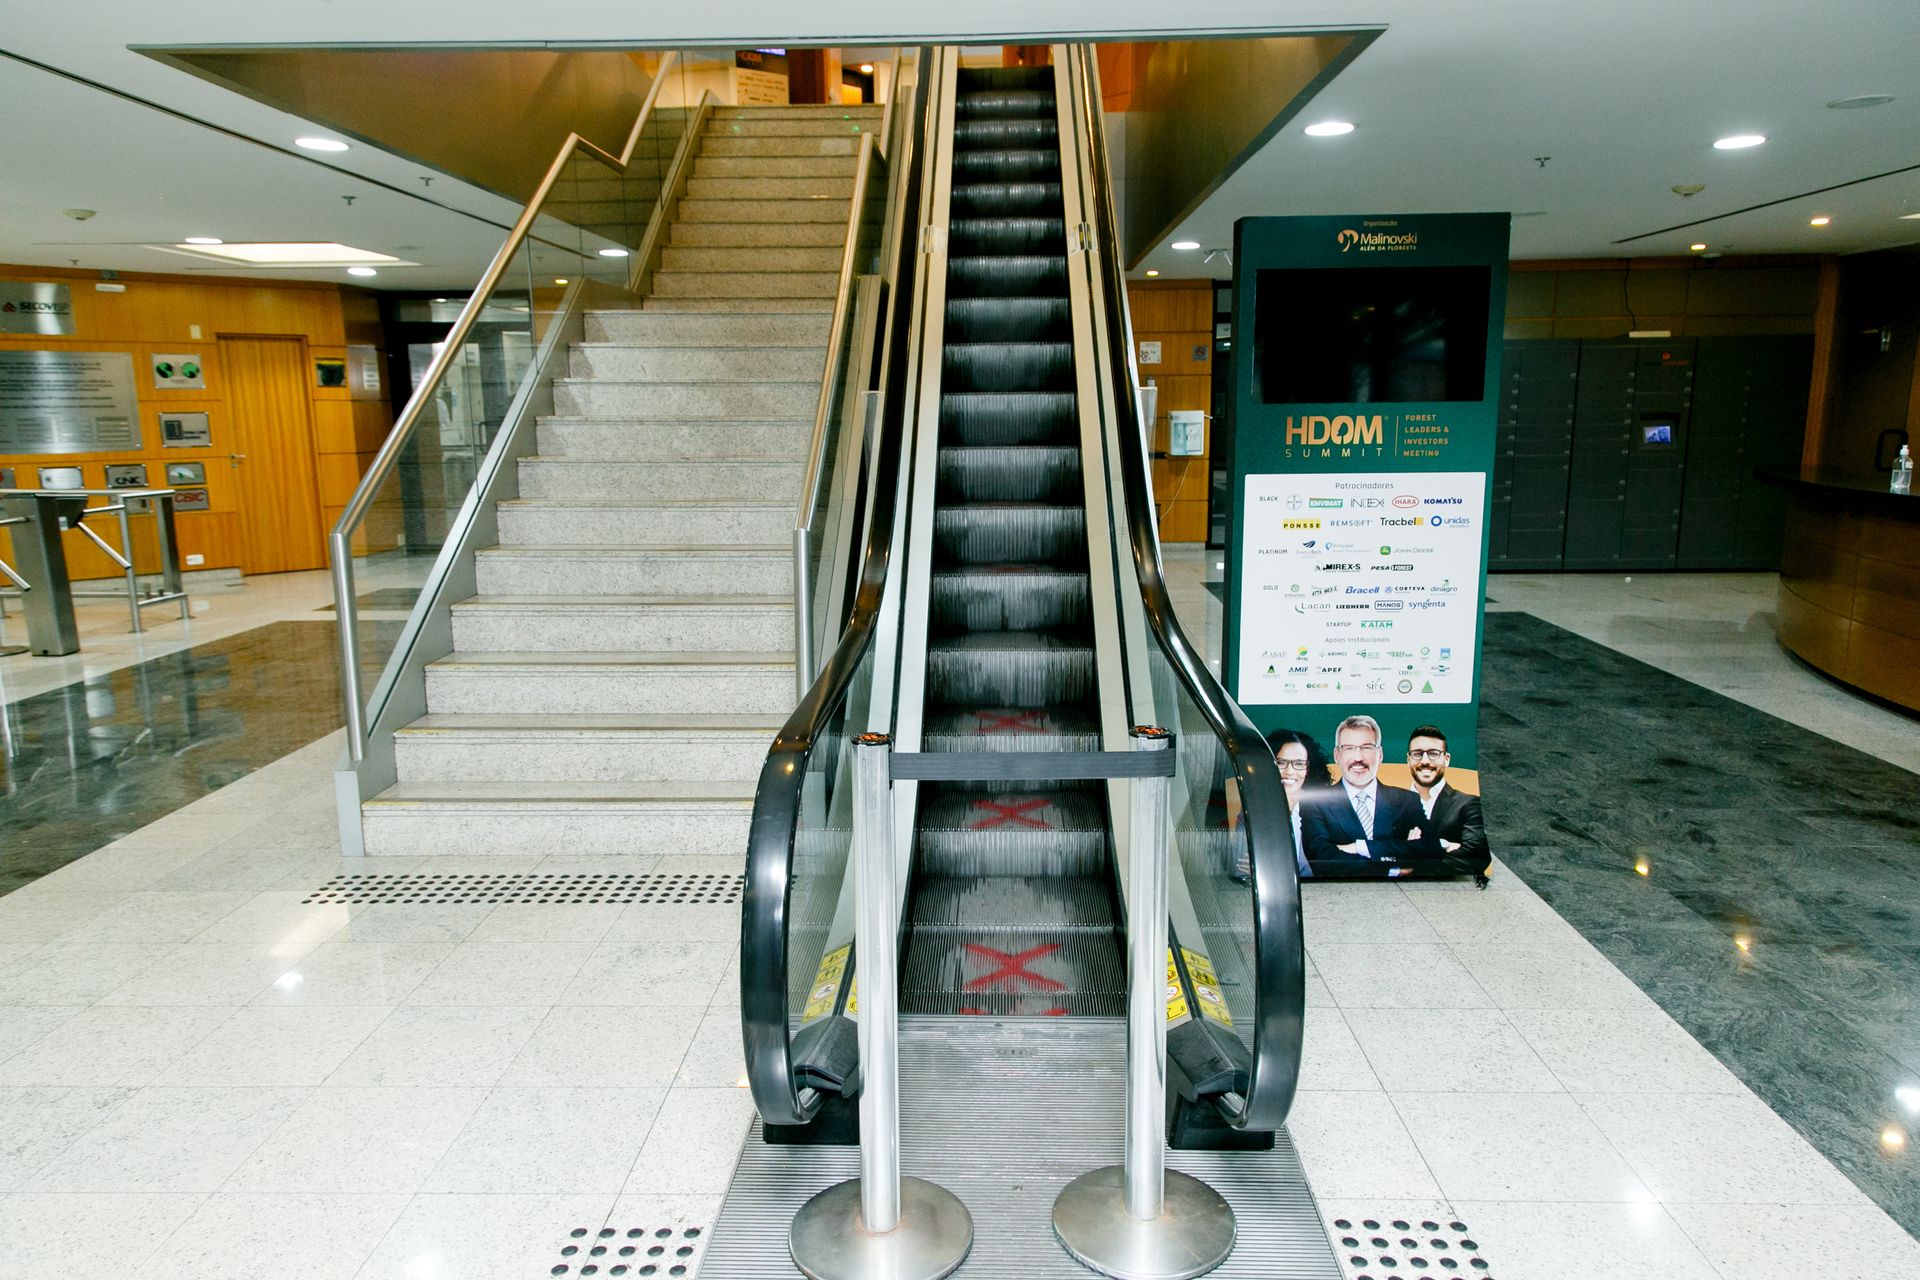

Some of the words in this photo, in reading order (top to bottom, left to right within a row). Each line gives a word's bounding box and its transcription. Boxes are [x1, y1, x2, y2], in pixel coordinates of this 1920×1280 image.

[1360, 232, 1418, 245] Malinovski
[1405, 414, 1436, 422] FOREST
[1286, 415, 1383, 446] HDOM
[1404, 425, 1441, 434] LEADERS
[1403, 437, 1449, 445] INVESTORS
[1285, 447, 1383, 458] SUMMIT
[1403, 449, 1440, 457] MEETING
[1335, 482, 1394, 490] Patrocinadores
[1380, 517, 1417, 526] Tracbel
[1444, 516, 1470, 525] unidas
[1345, 586, 1381, 594] Bracell
[1408, 598, 1447, 610] syngenta
